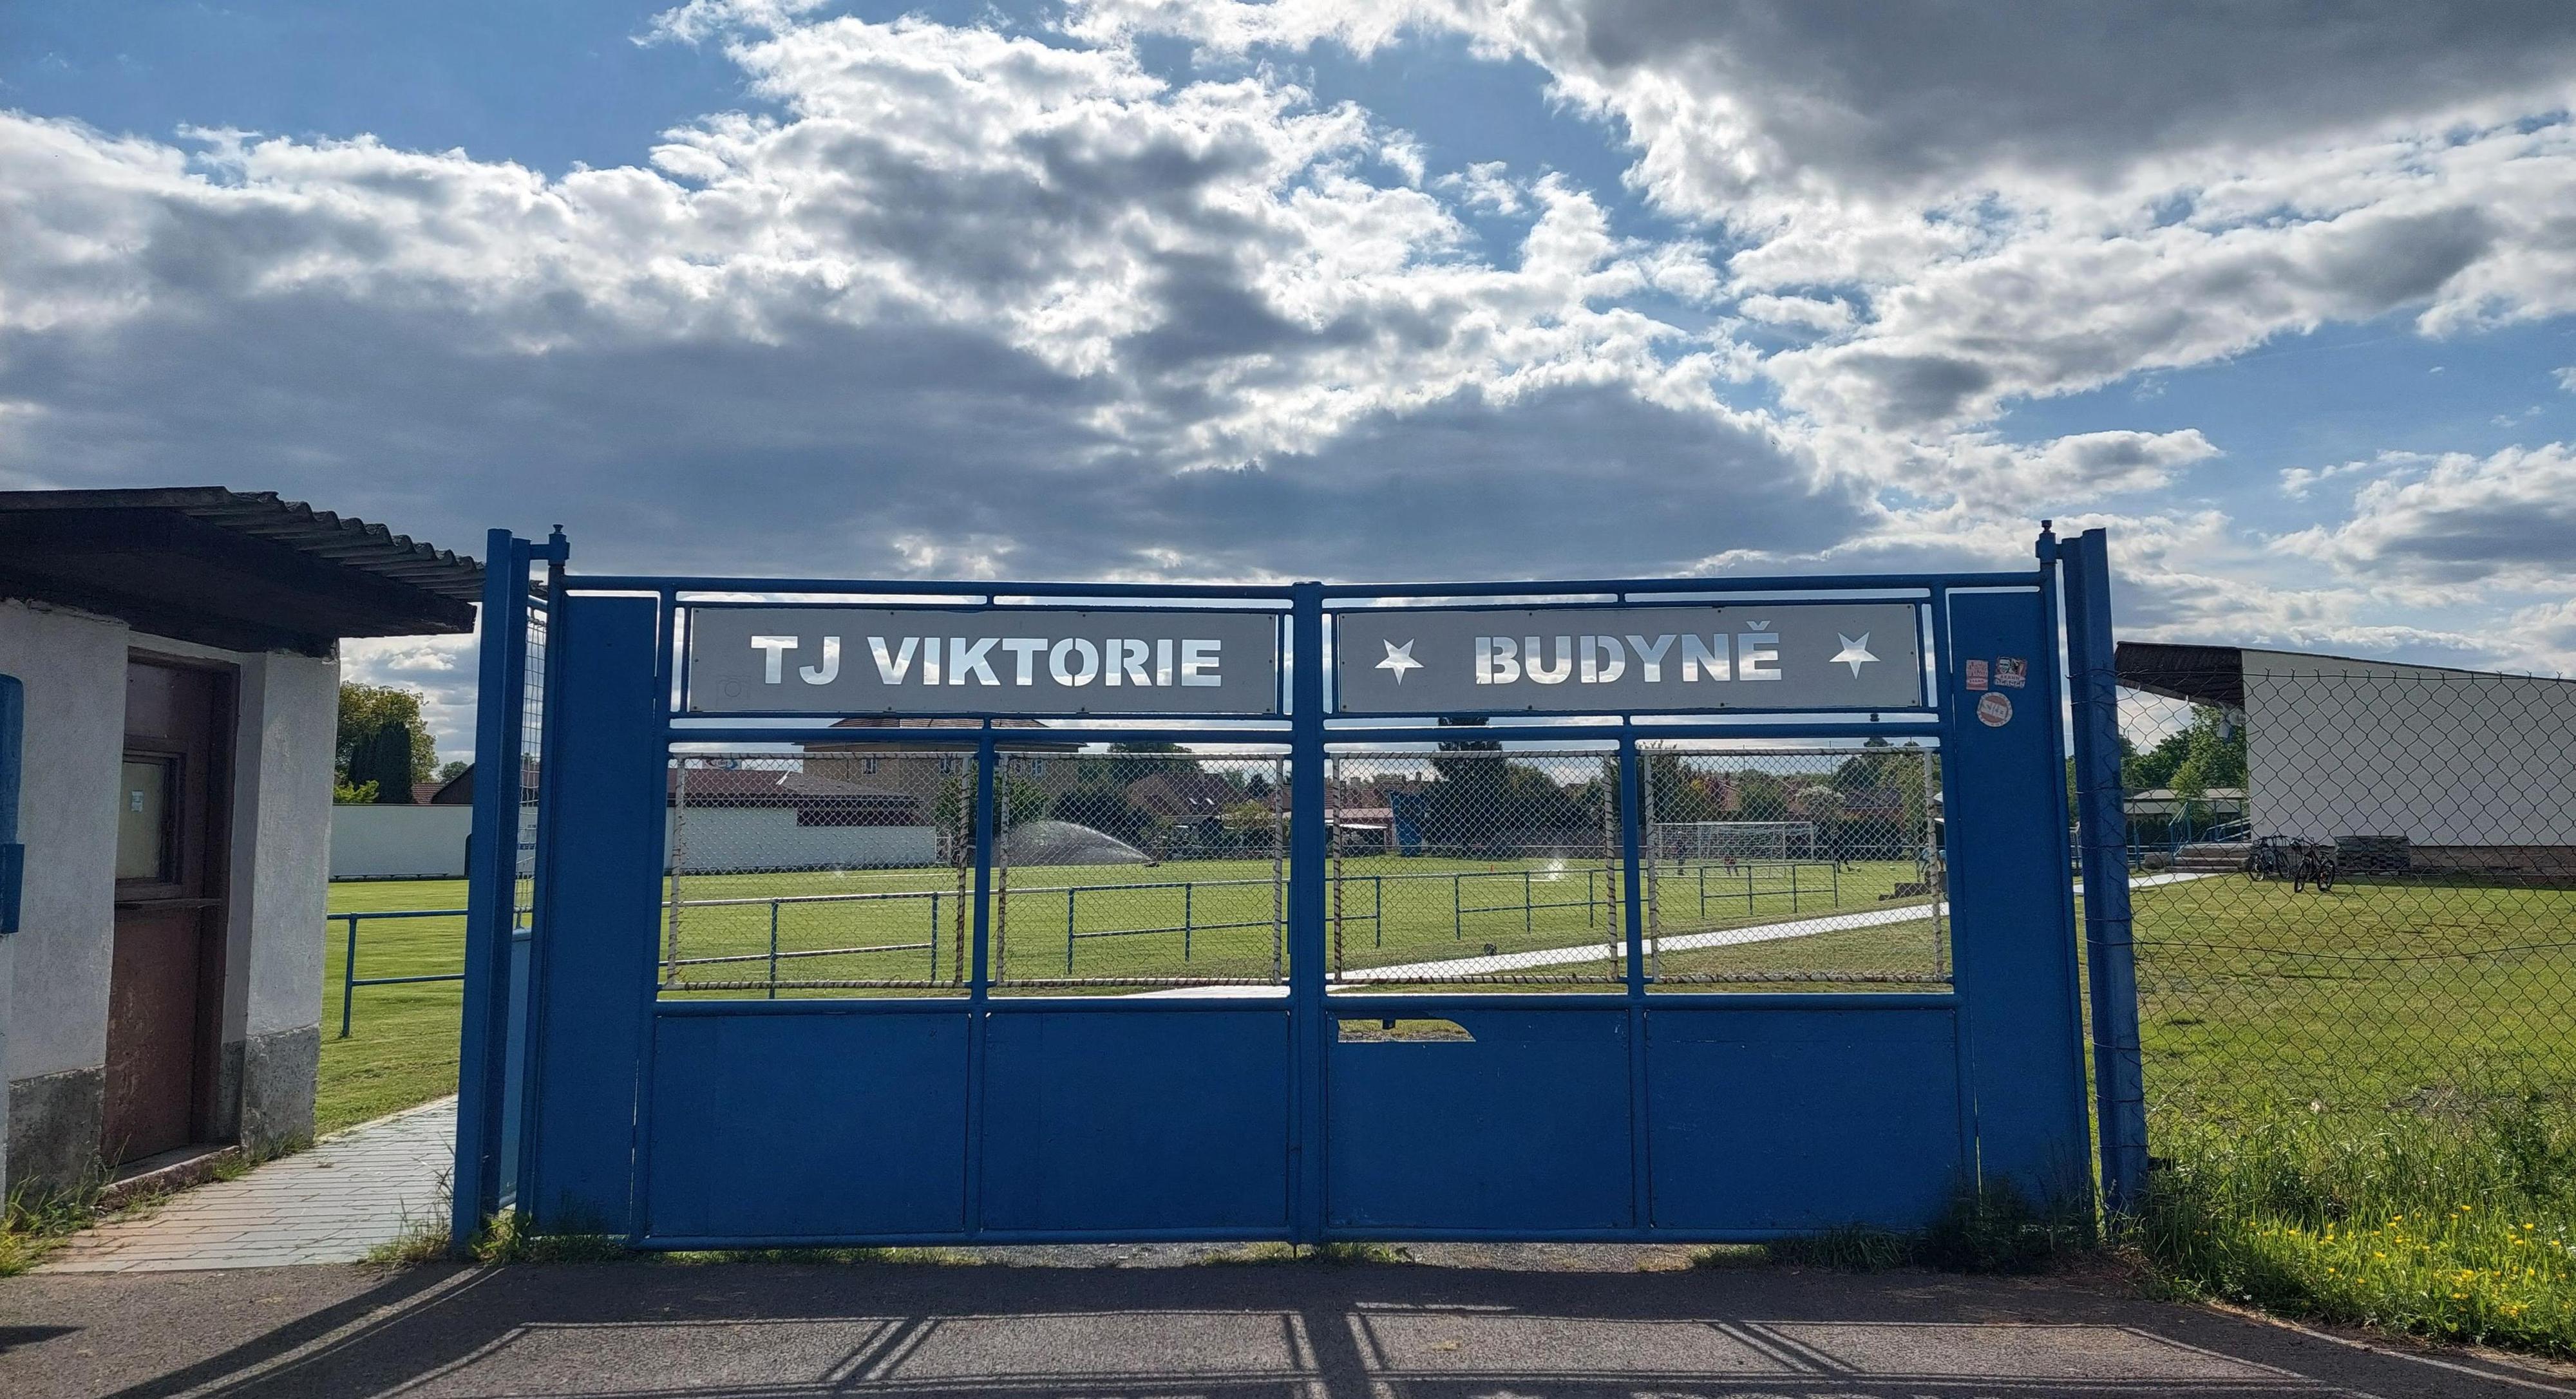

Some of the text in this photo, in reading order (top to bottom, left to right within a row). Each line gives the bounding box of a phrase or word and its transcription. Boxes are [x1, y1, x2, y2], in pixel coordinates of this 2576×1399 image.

[751, 636, 1221, 686] TJ VIKTORIE
[1475, 621, 1782, 684] BUDYNĚ
